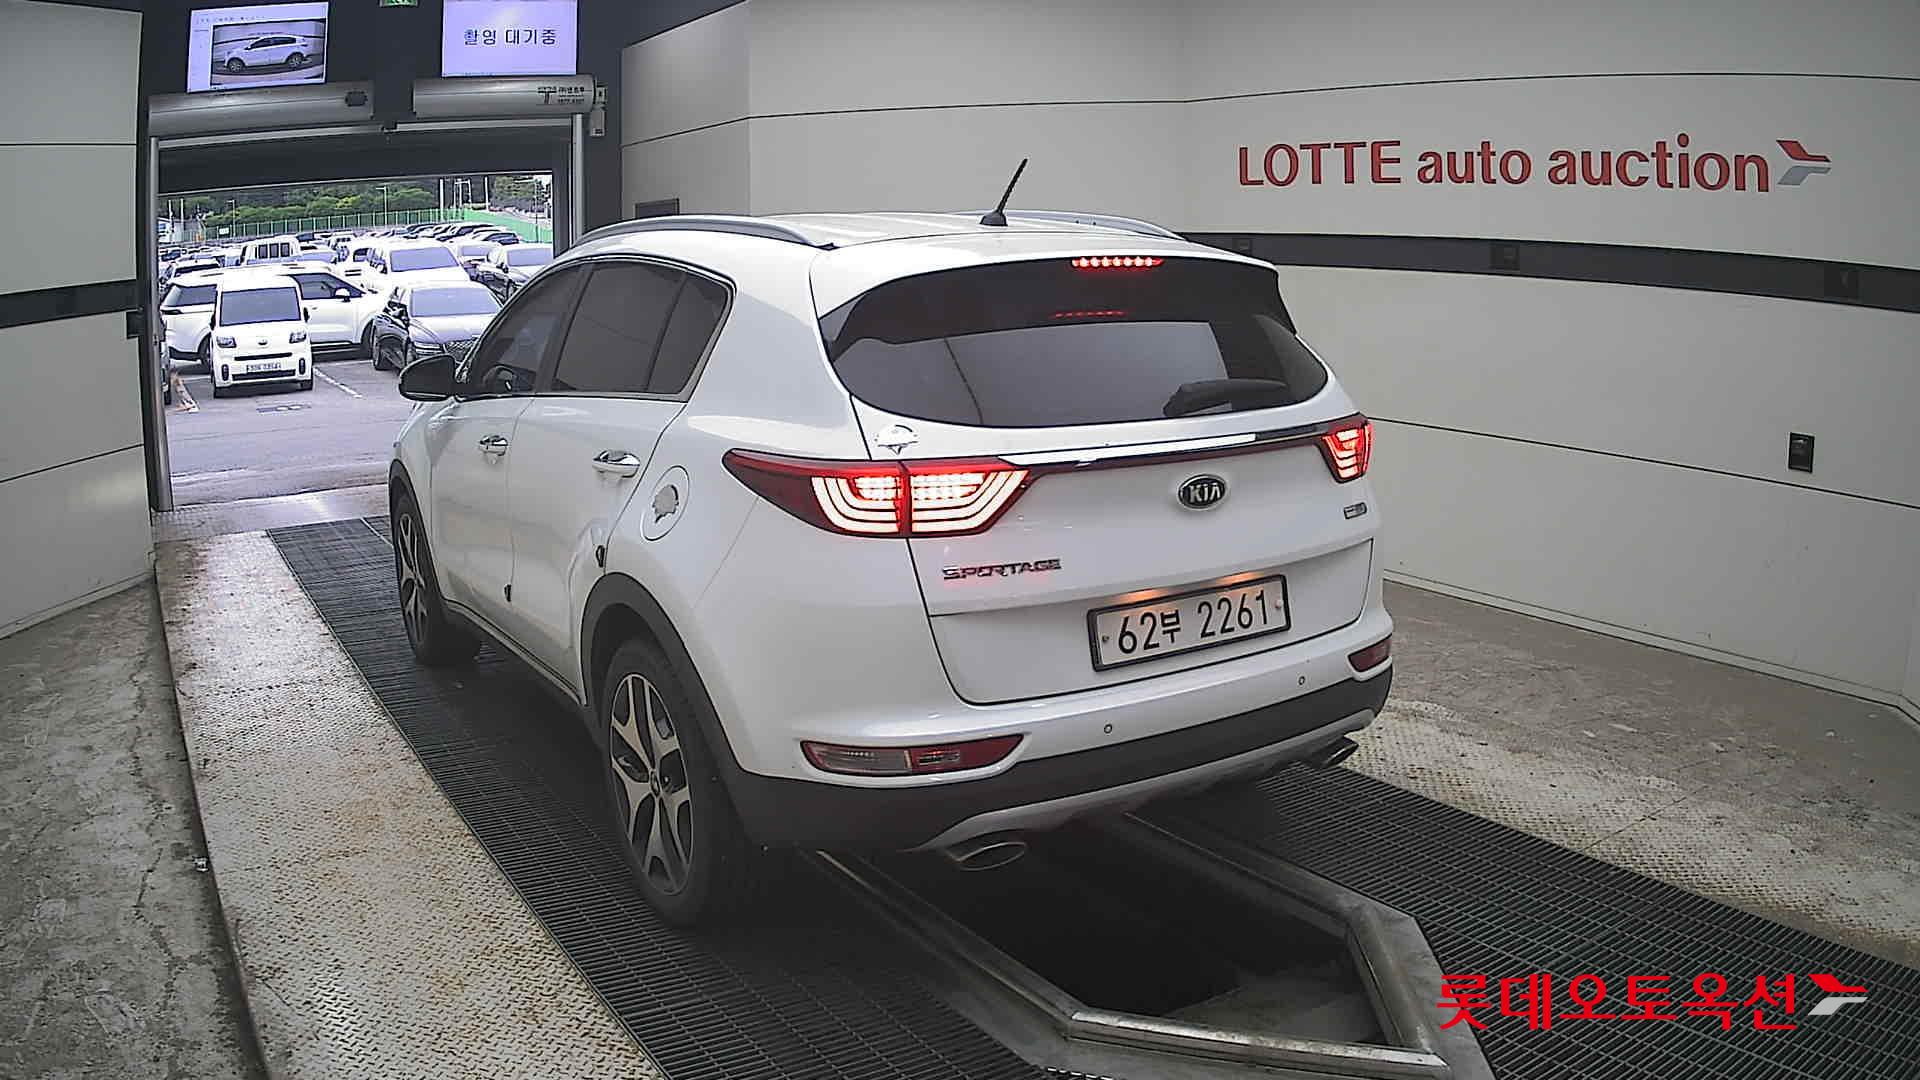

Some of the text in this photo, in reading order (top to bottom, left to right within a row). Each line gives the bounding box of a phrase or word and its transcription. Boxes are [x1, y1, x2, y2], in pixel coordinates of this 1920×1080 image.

[505, 29, 556, 45] 대기중
[1238, 133, 1769, 192] LOTTE auto auction
[1189, 482, 1221, 503] KIA
[942, 559, 1061, 580] SPORTAGE
[1118, 589, 1267, 655] 62부 2261
